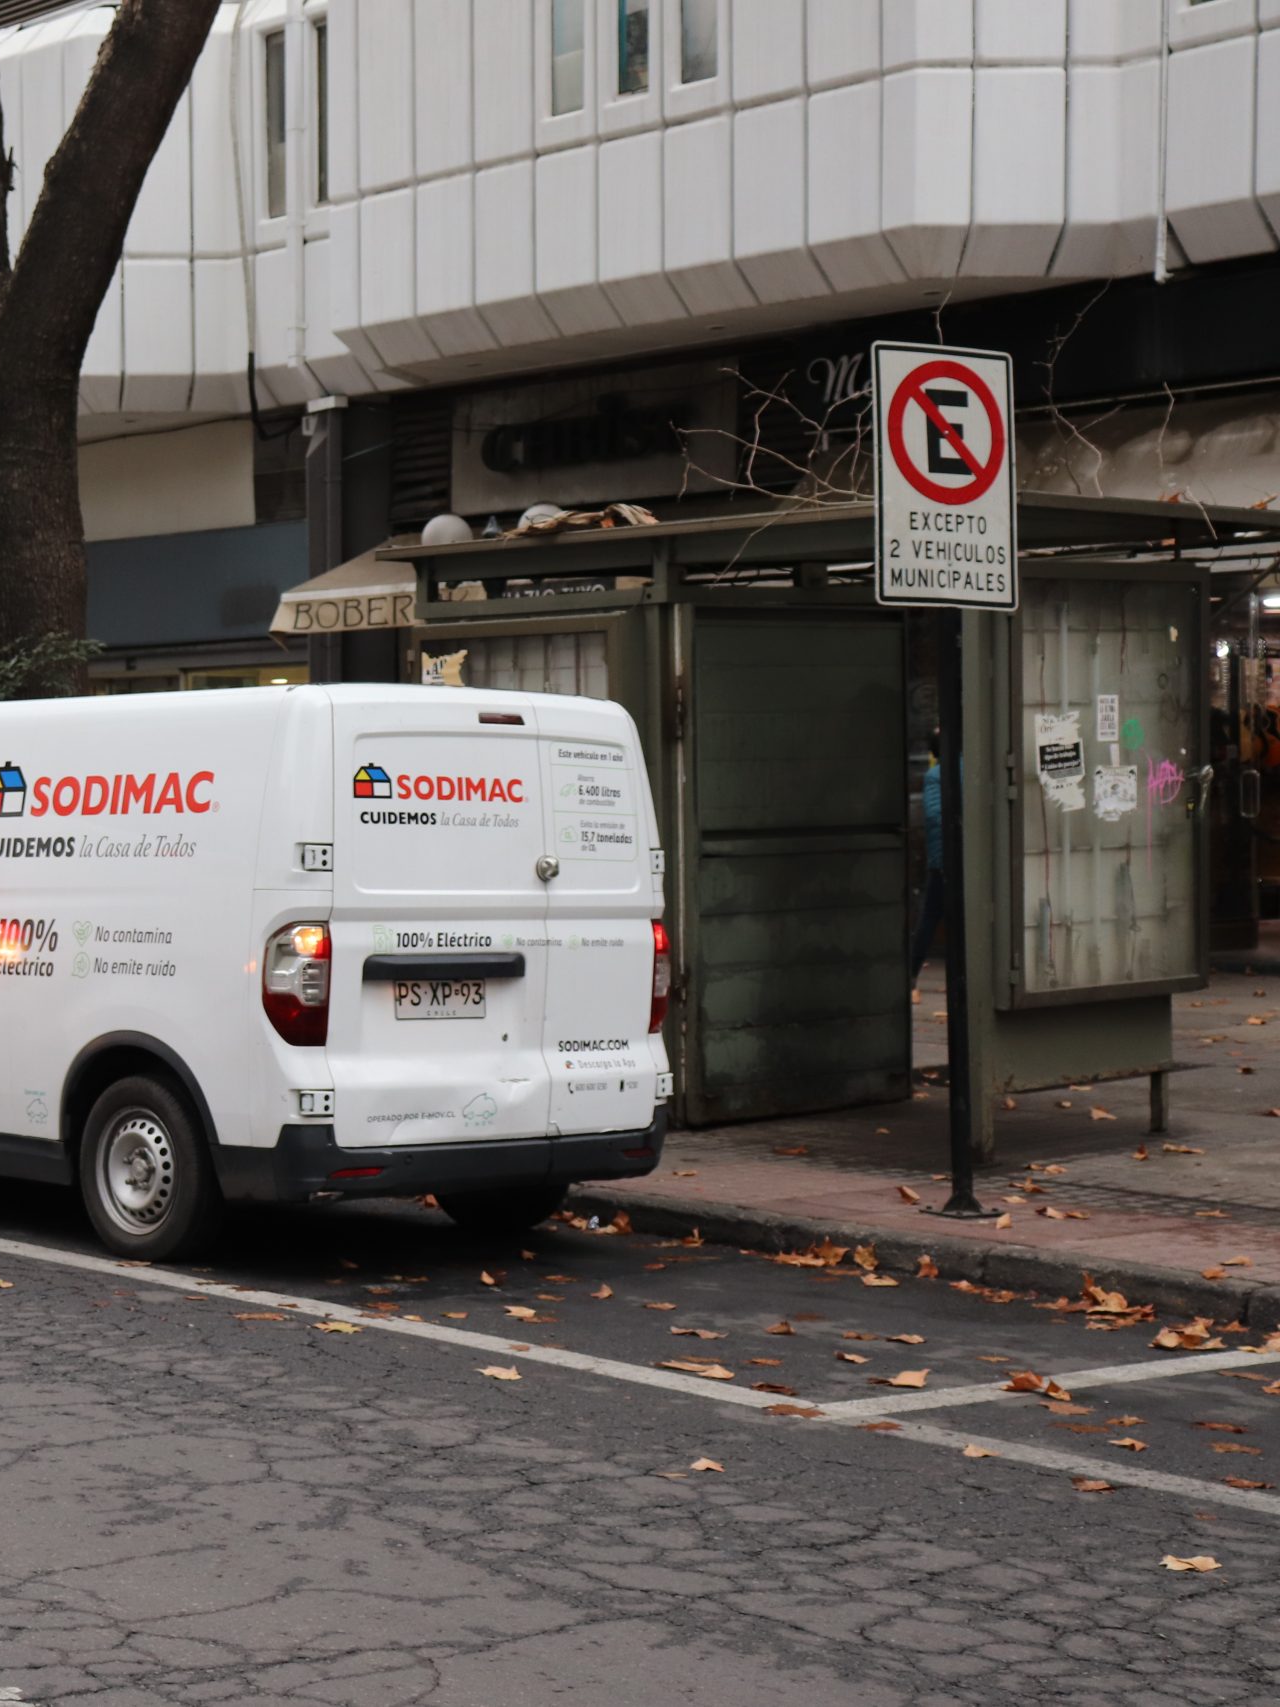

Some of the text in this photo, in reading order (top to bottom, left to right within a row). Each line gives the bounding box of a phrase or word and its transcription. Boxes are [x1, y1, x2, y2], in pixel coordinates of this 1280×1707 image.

[925, 388, 973, 475] E
[910, 511, 987, 535] EXCEPTO
[890, 539, 1006, 565] 2 VEHICULOS
[890, 567, 1006, 592] MUNICIPALES
[360, 811, 520, 828] CUIDEMOS la Casa de Todos
[79, 835, 92, 858] la
[96, 836, 131, 858] Casa
[134, 834, 152, 858] de
[154, 834, 197, 858] Todos
[94, 926, 173, 944] No contamina
[396, 932, 492, 948] 100% Eléctrico
[93, 958, 176, 977] No emite ruido
[558, 1040, 630, 1052] SODIMAC.COM
